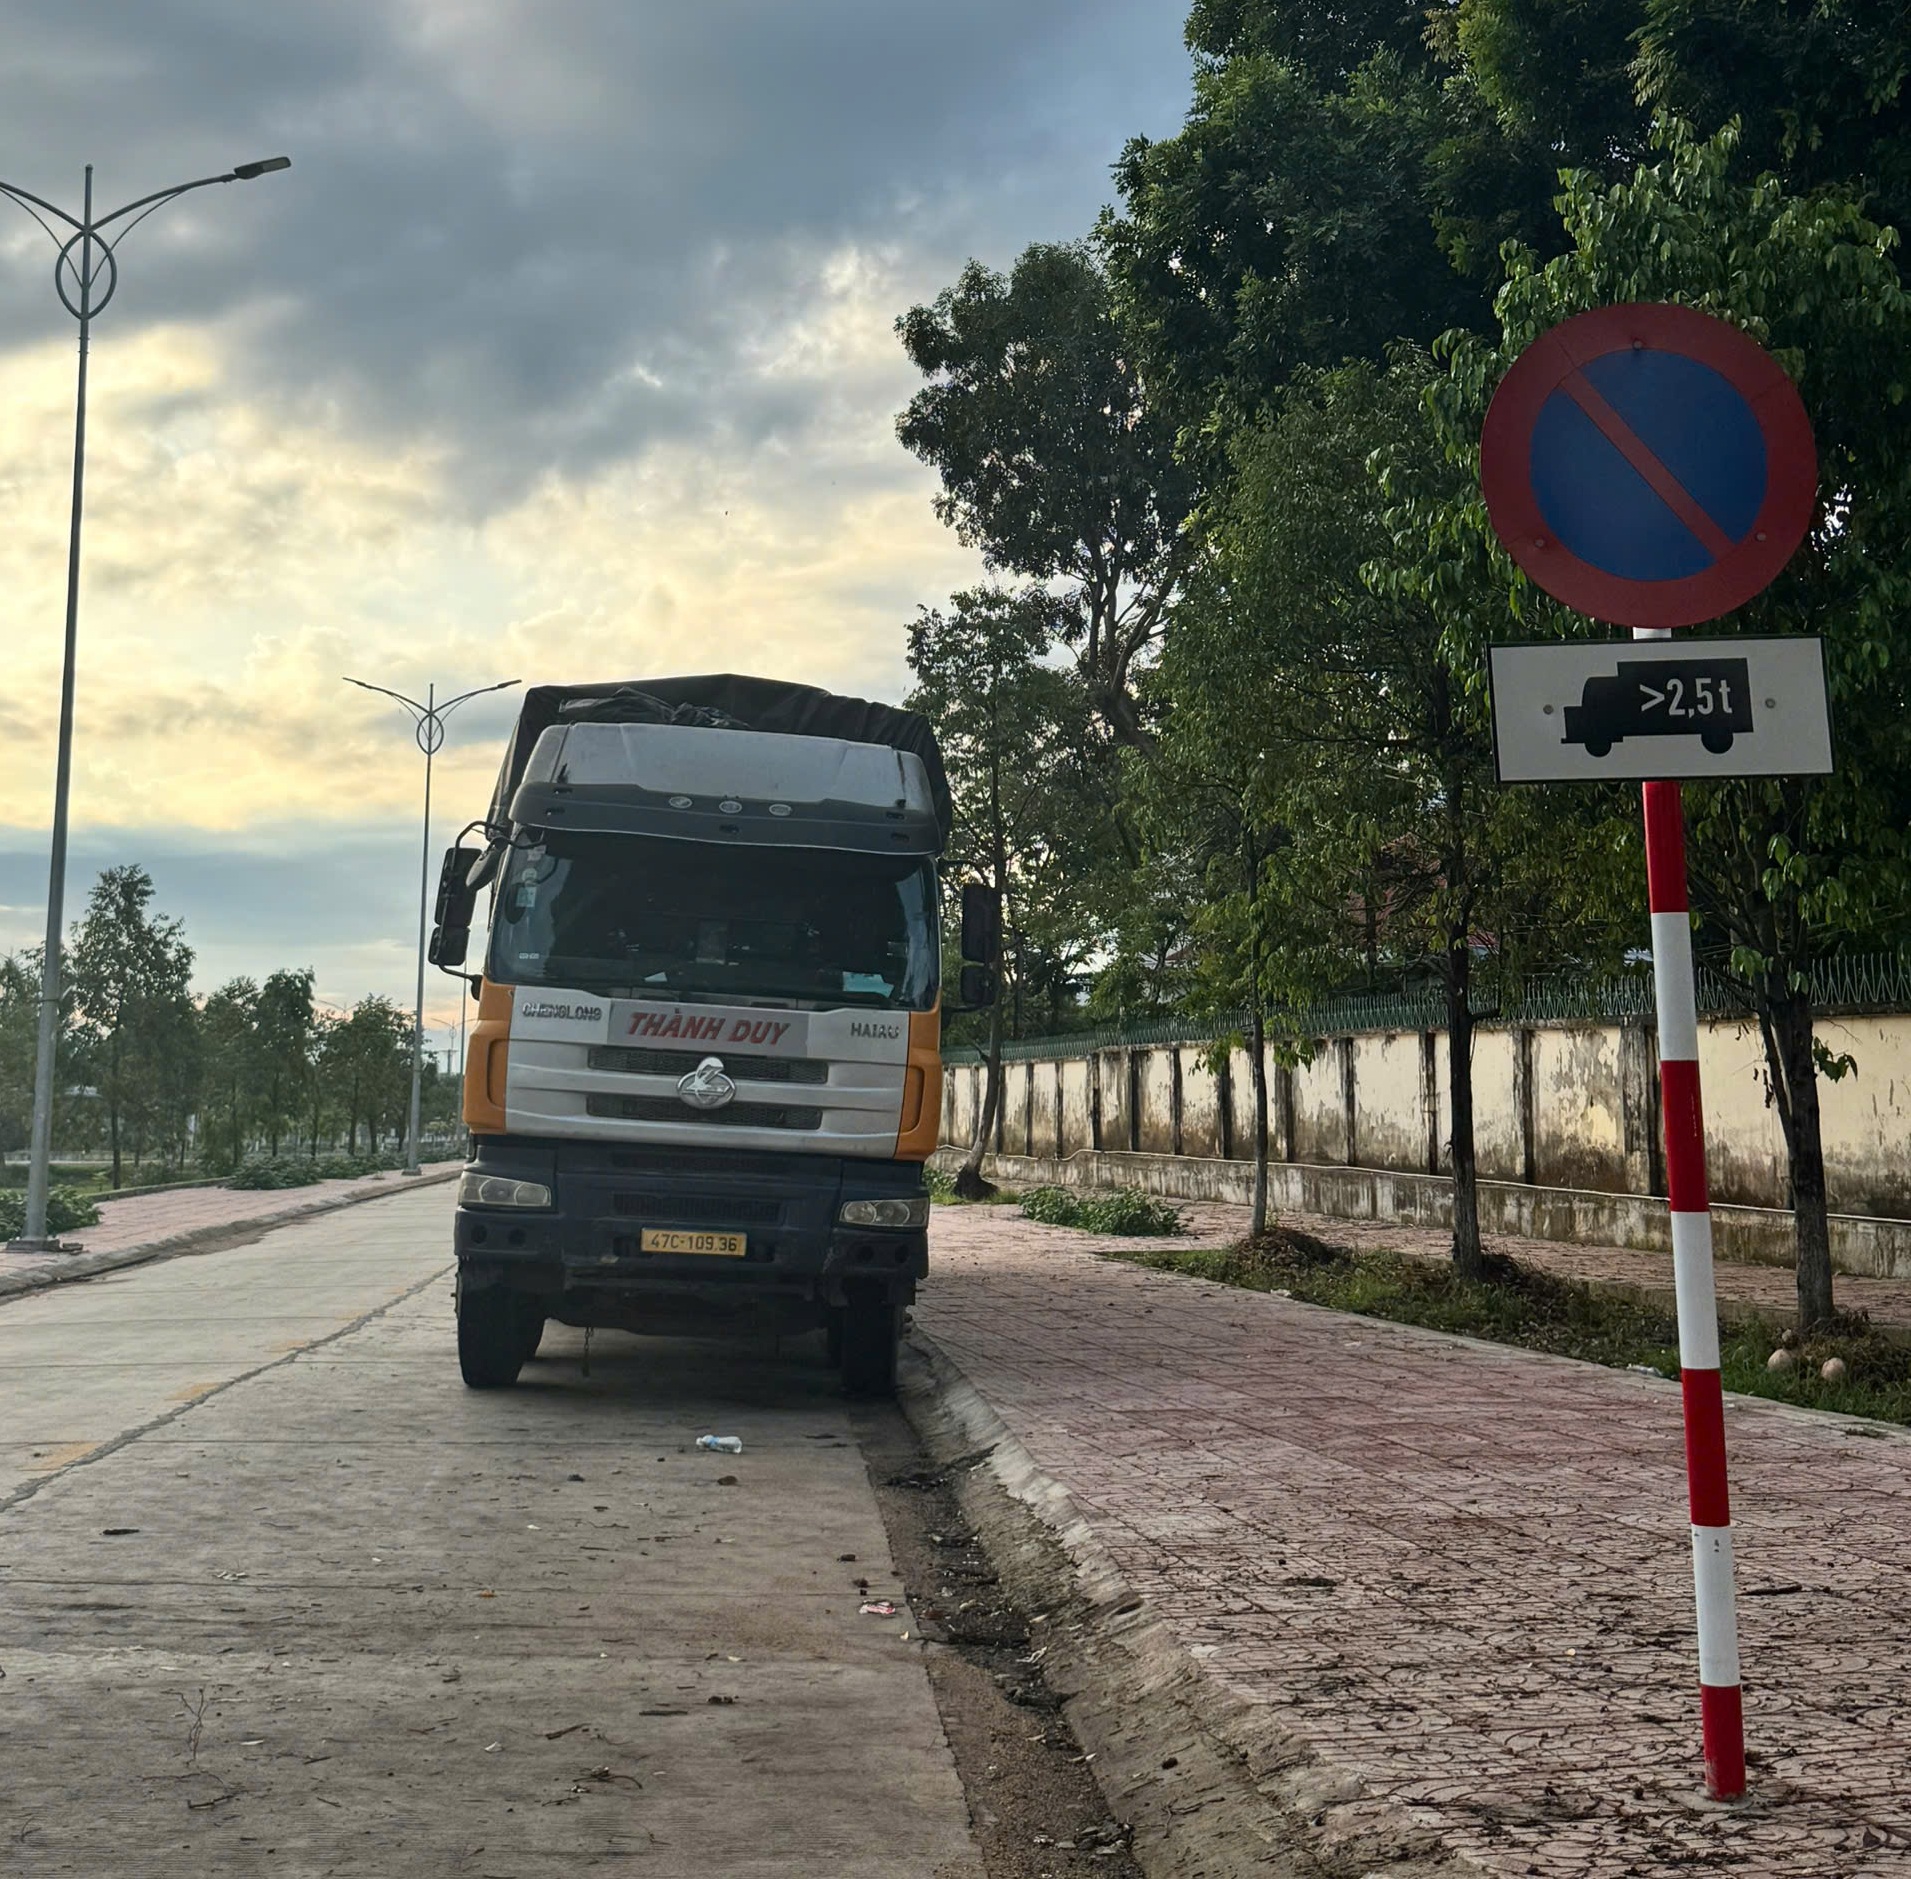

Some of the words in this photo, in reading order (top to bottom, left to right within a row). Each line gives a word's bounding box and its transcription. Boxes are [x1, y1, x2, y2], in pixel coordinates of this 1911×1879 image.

[1639, 678, 1732, 718] >2,5t
[627, 1007, 726, 1041] THÀNH
[727, 1019, 791, 1046] DUY
[651, 1233, 738, 1252] 47C-109.36
